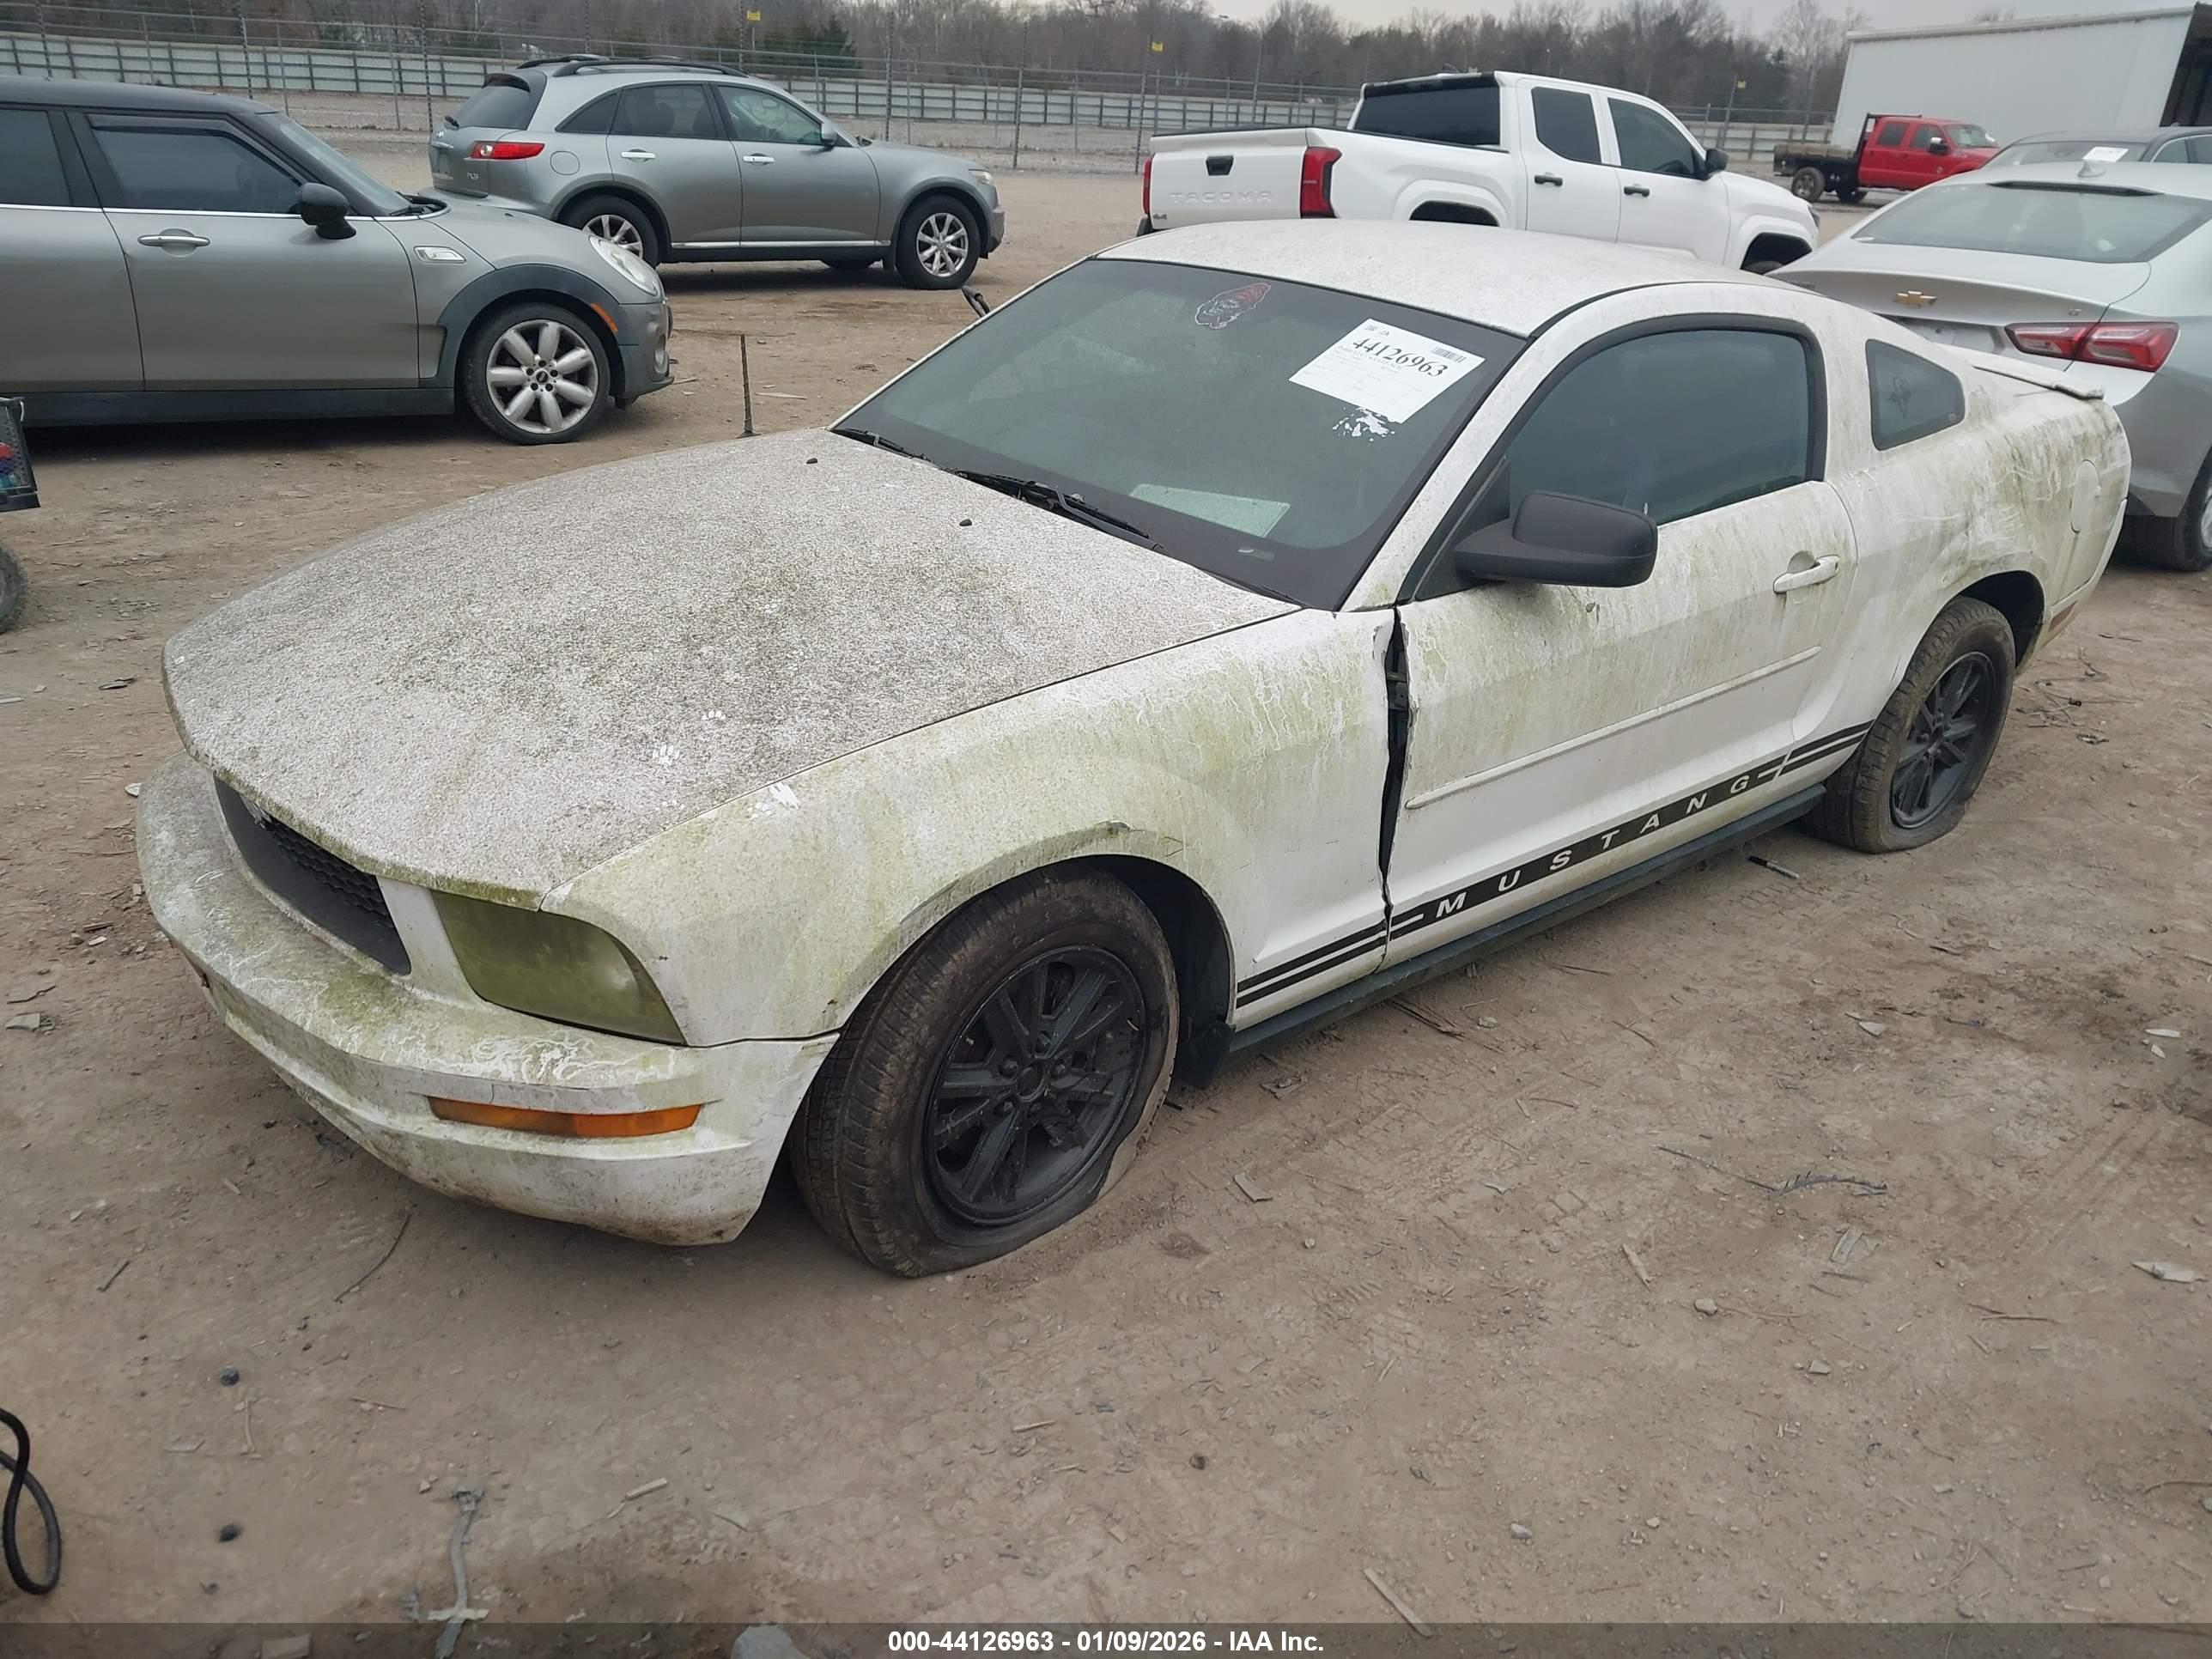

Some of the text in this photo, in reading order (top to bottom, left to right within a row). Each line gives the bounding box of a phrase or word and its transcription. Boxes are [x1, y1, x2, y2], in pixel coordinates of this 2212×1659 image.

[1170, 192, 1272, 204] TACOMA
[1353, 338, 1448, 376] 44126963
[1436, 774, 1751, 918] MUSTANG
